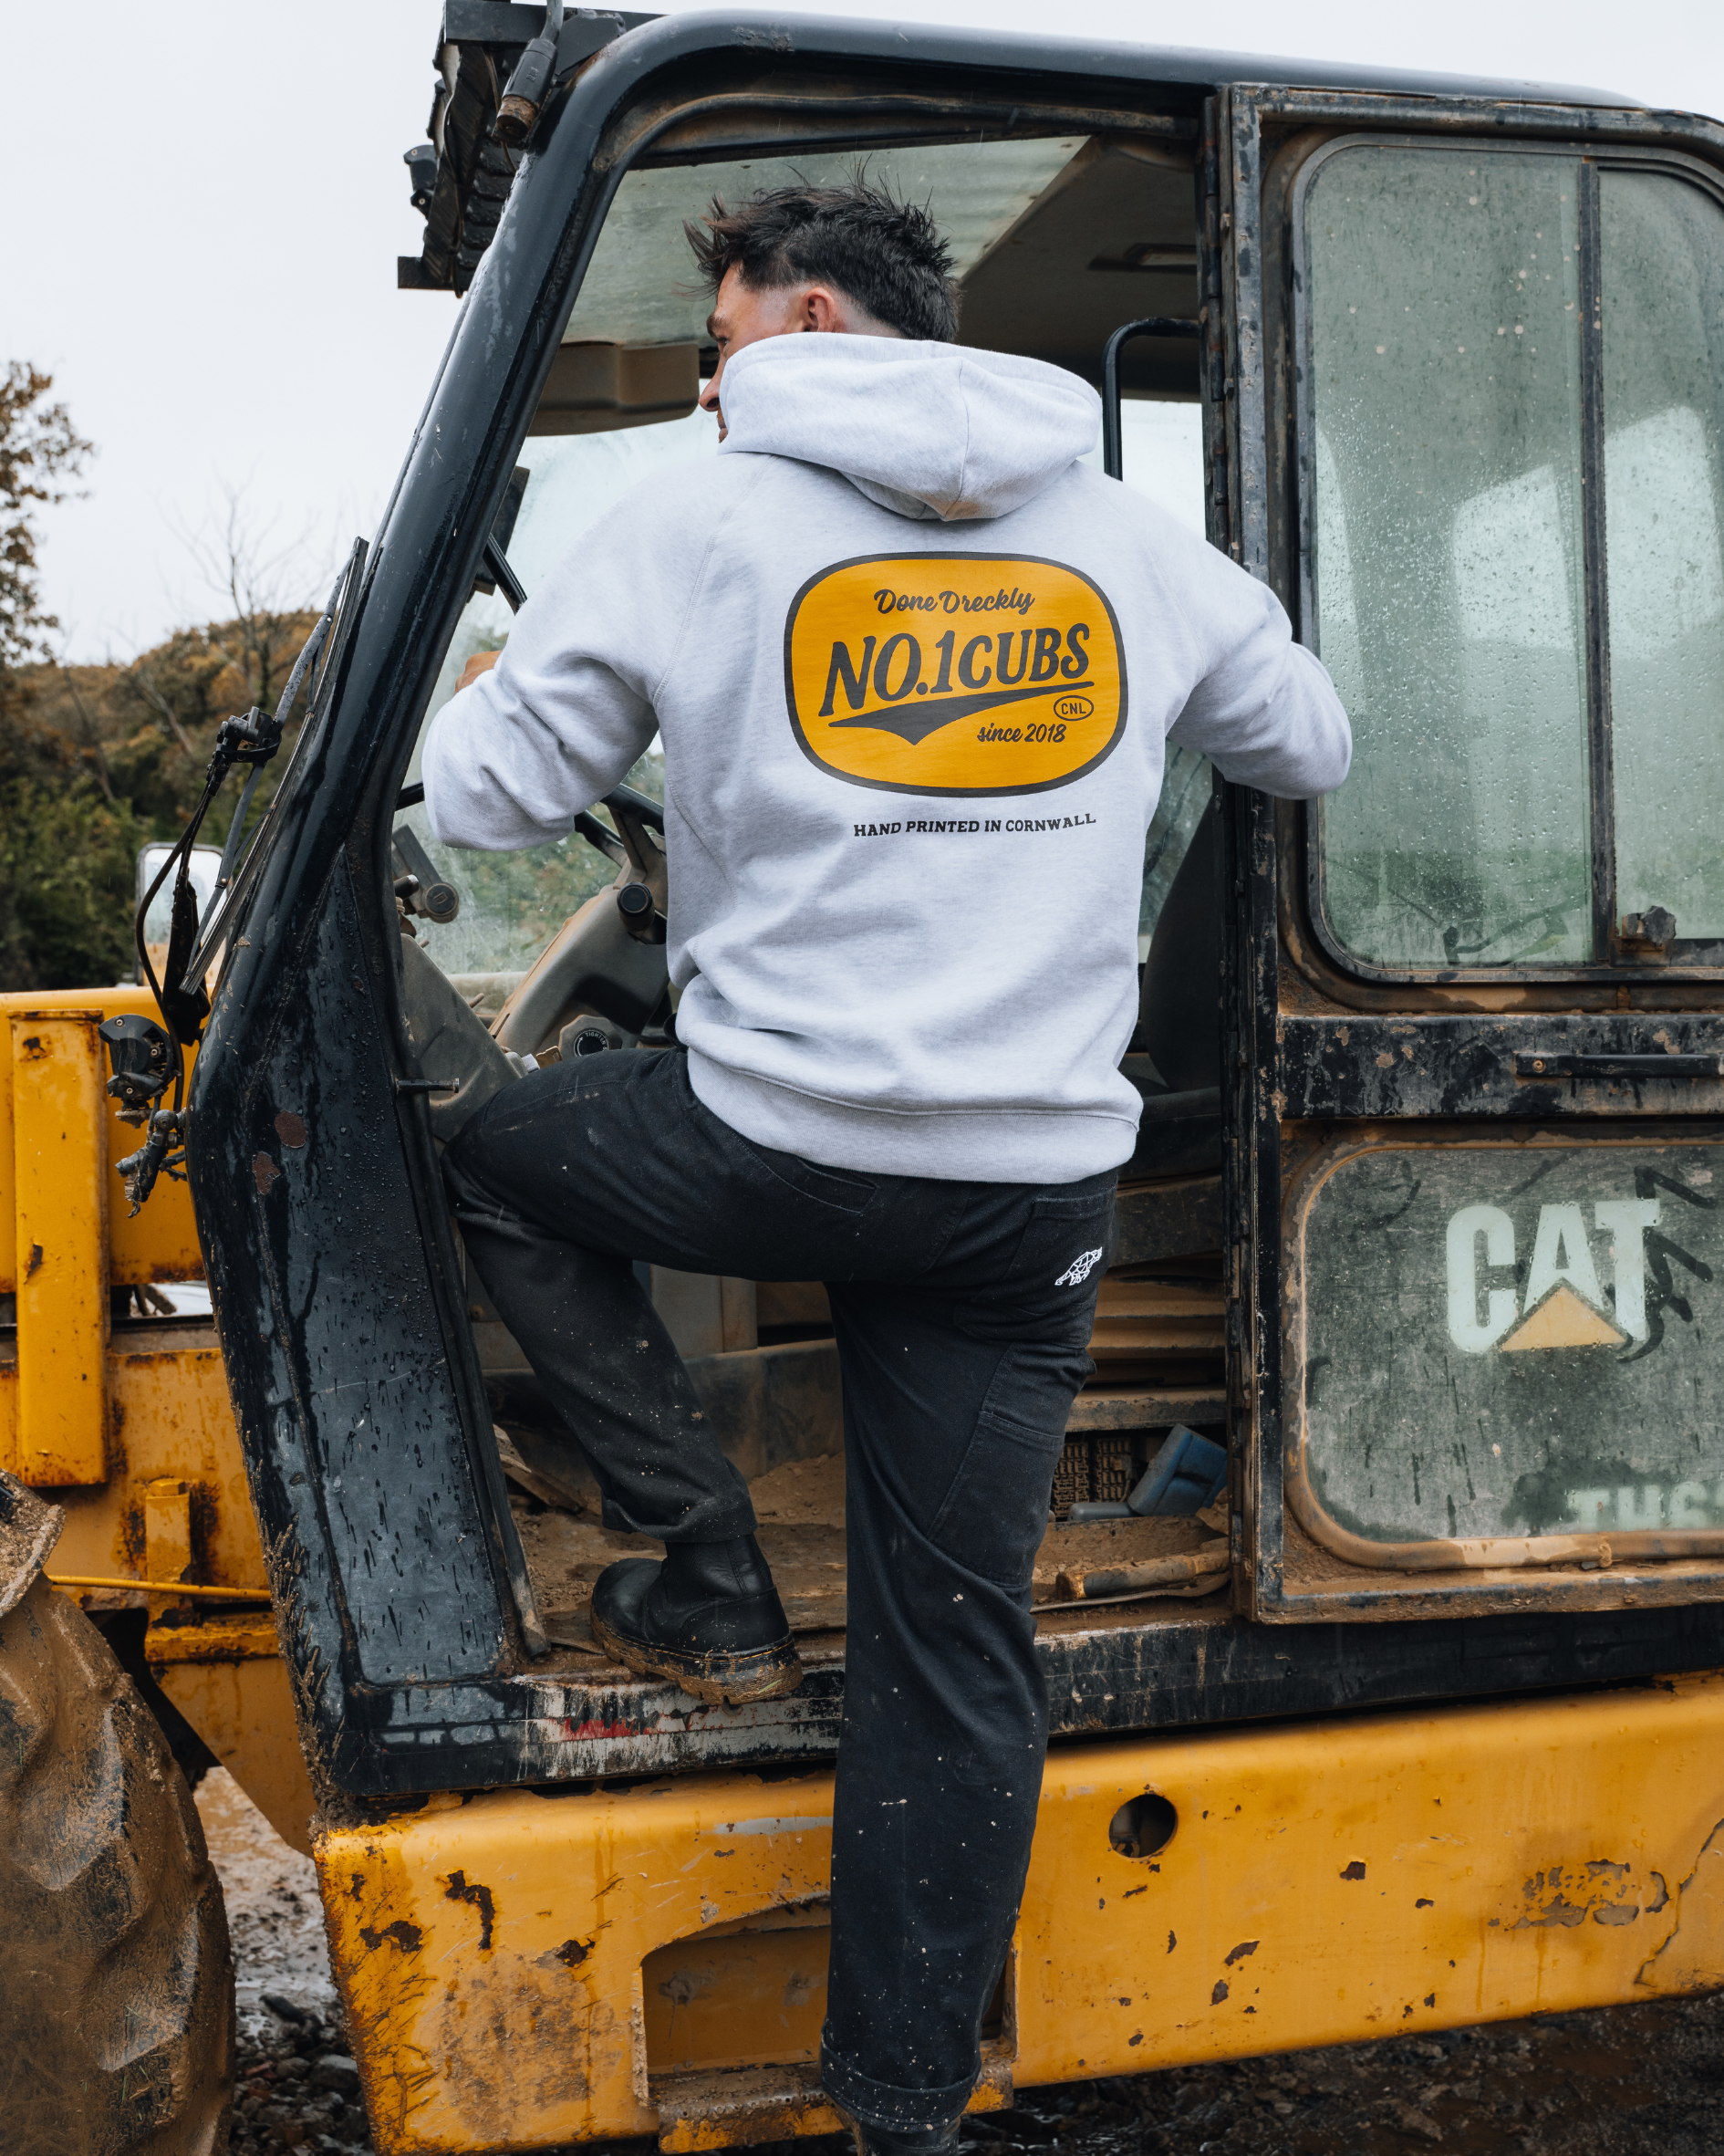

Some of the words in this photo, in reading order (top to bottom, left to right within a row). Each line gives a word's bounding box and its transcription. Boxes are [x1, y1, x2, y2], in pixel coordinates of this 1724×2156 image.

[873, 588, 938, 614] Done
[938, 587, 1035, 617] Dreckly
[1060, 702, 1086, 716] CNL
[976, 723, 1023, 744] since
[1023, 723, 1067, 744] 2018
[853, 821, 902, 838] HAND
[905, 819, 980, 834] PRINTED
[983, 818, 1002, 833] IN
[1004, 813, 1096, 832] CORNWALL
[1446, 1198, 1660, 1354] CAT
